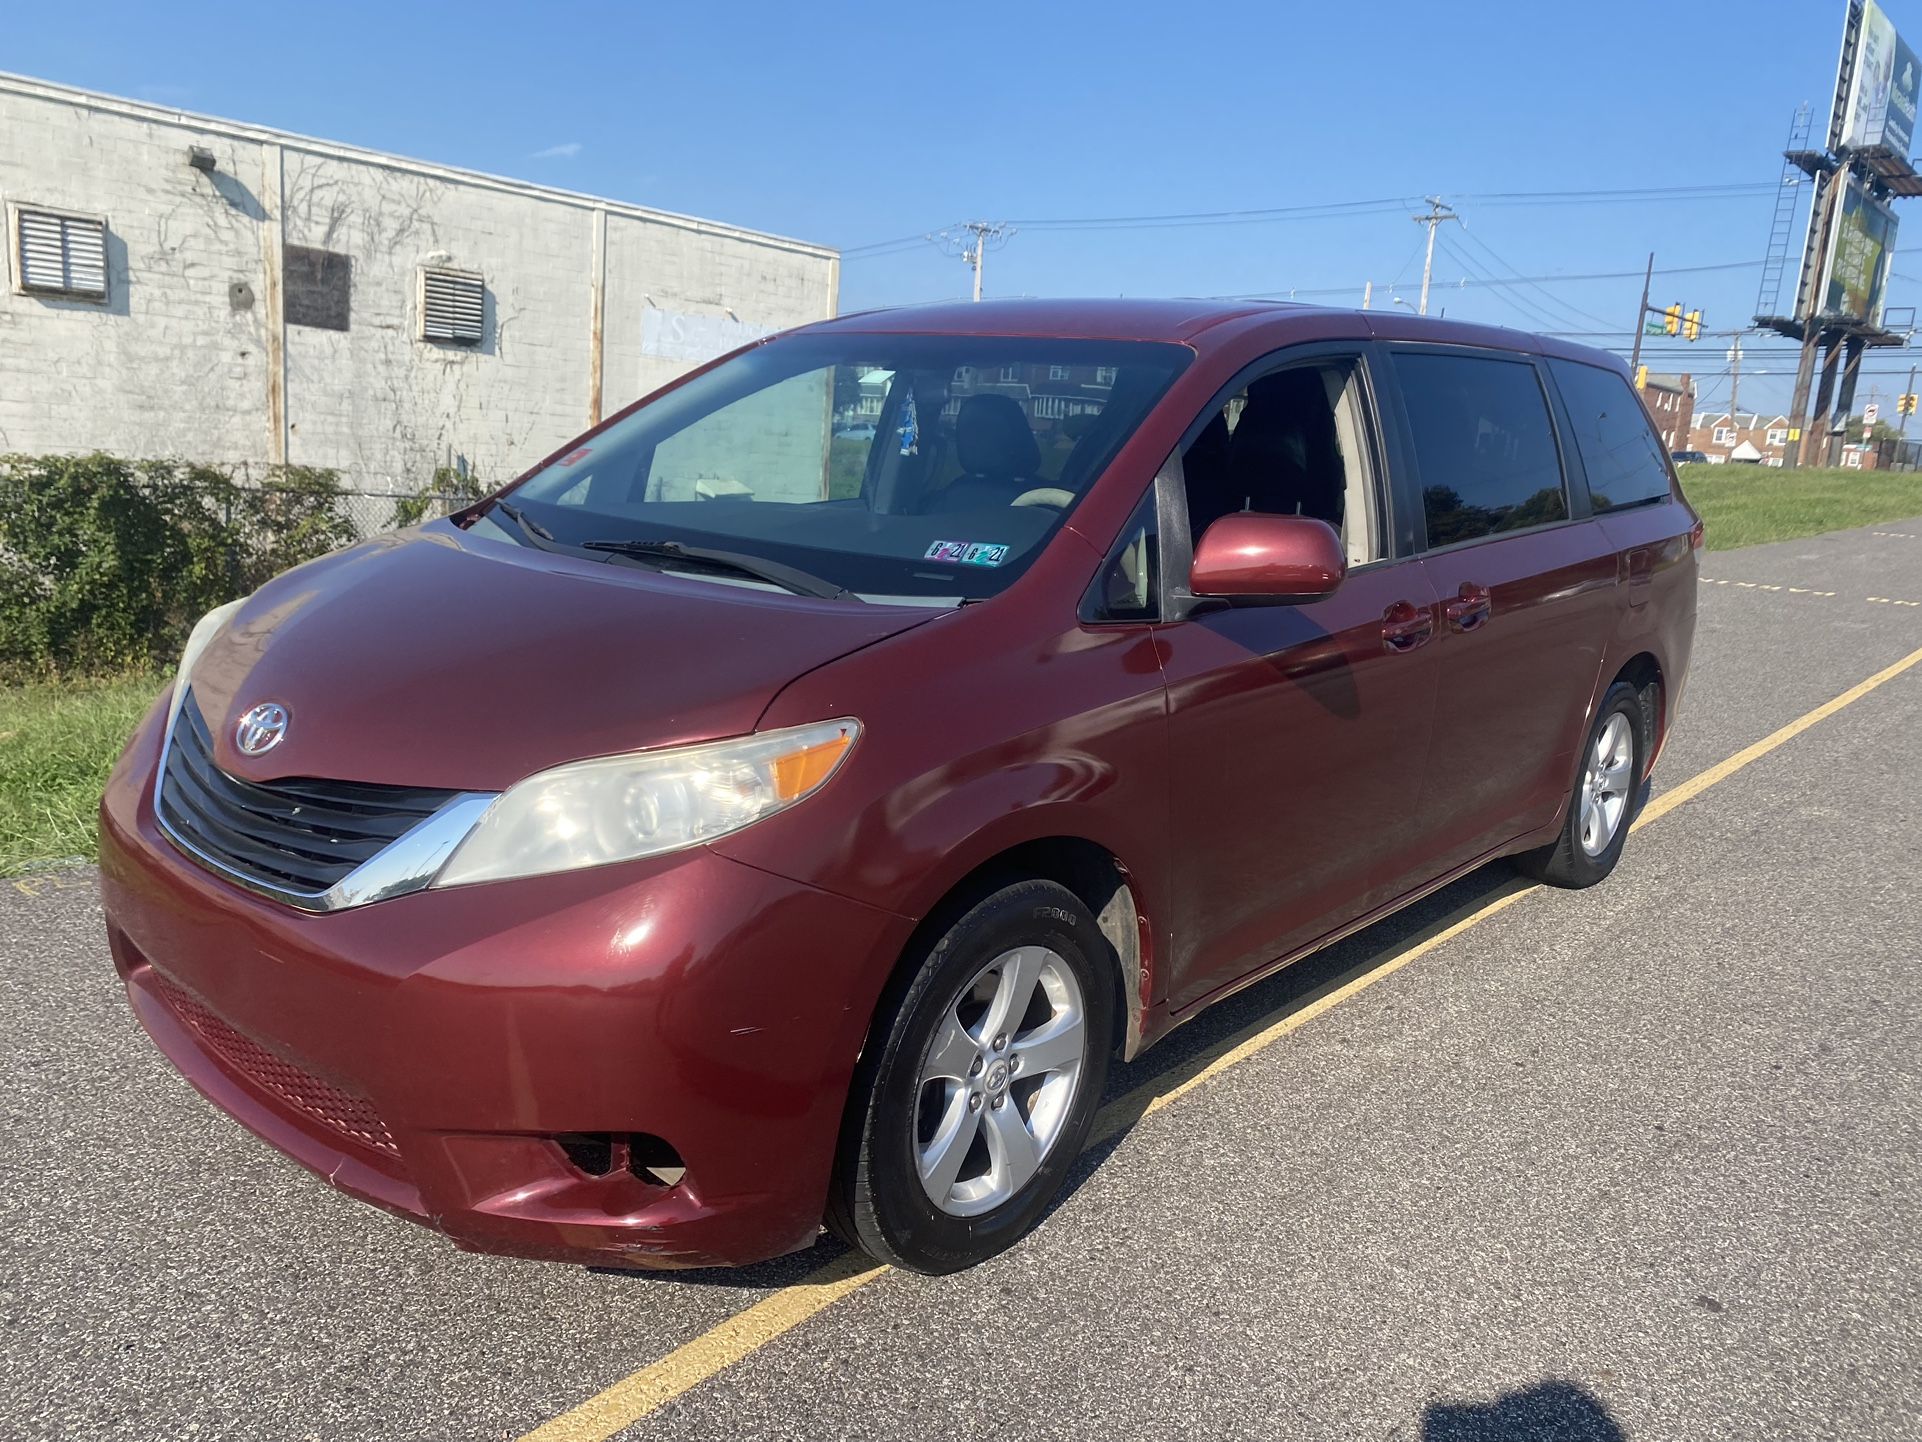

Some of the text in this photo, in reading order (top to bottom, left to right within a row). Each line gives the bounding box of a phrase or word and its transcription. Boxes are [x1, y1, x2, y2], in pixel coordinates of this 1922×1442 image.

[931, 542, 966, 558] 6 21
[968, 546, 1004, 562] 6 21
